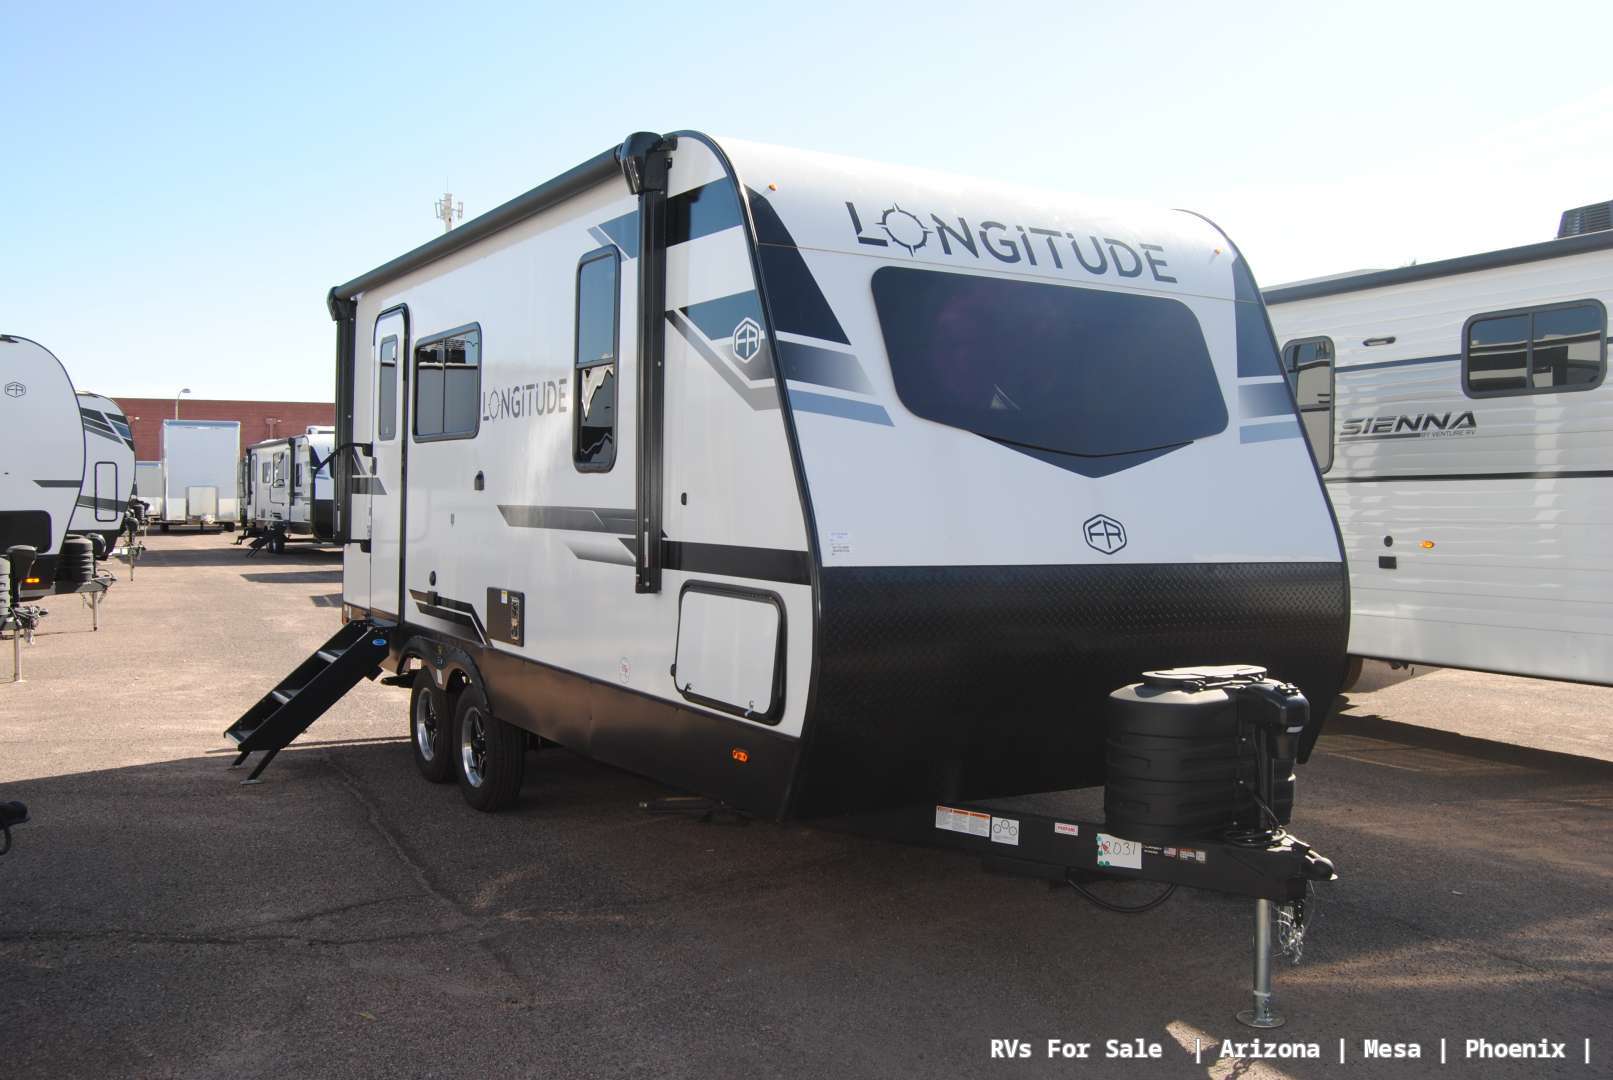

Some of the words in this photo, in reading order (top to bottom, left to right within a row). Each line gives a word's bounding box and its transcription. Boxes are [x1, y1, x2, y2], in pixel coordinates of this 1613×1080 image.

[846, 201, 1178, 284] LONGITUDE
[482, 378, 567, 422] LONGITUDE
[1339, 411, 1477, 436] SIENNA
